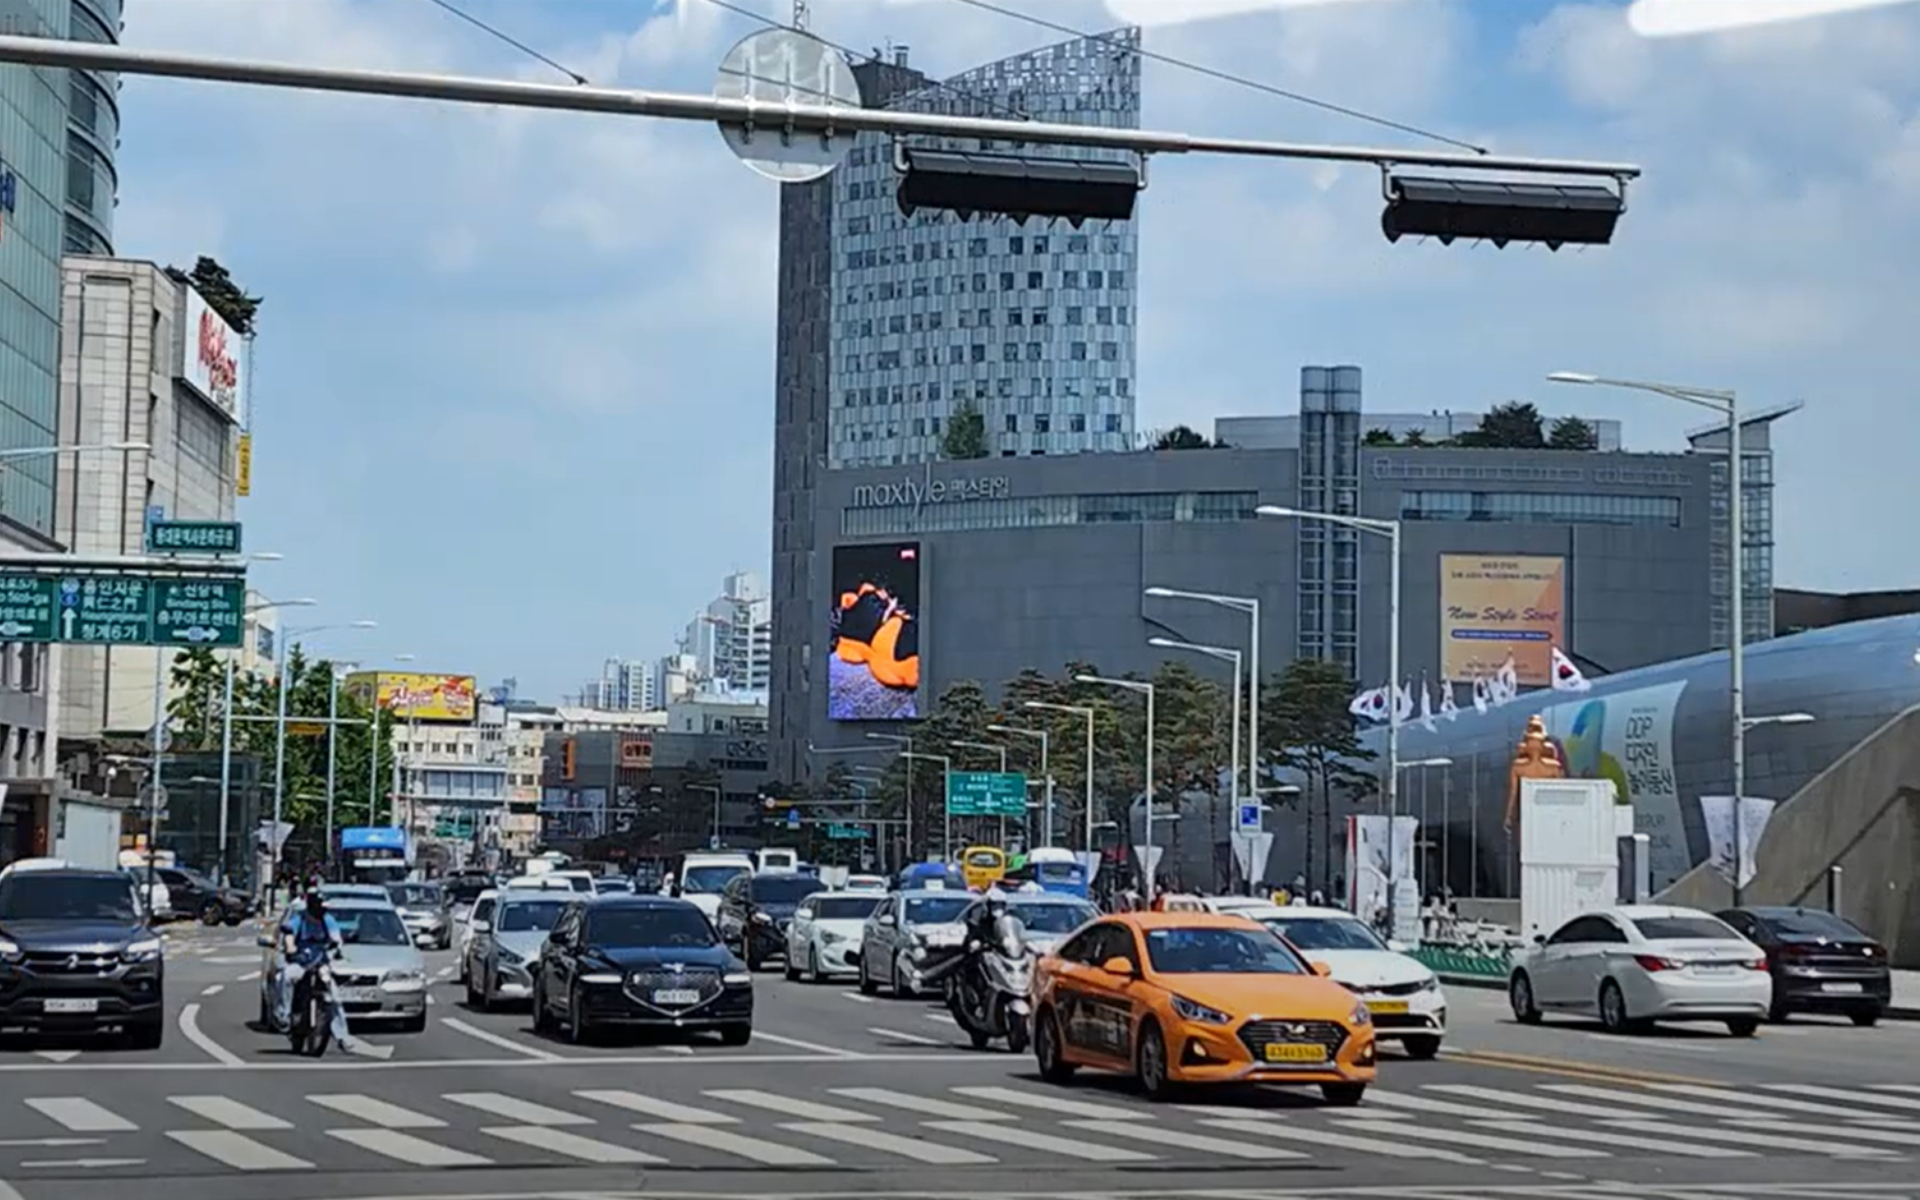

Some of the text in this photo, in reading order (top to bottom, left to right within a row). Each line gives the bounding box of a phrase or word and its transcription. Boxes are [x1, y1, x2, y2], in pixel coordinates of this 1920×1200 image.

[854, 461, 1009, 516] maxtyle 맥스타일
[83, 579, 143, 597] 흥인지문
[184, 584, 224, 598] 신당역
[1447, 606, 1478, 620] New
[1481, 606, 1517, 622] Style
[82, 623, 139, 640] 청계6가
[1625, 716, 1653, 739] DDP
[1625, 742, 1658, 768] 디자인
